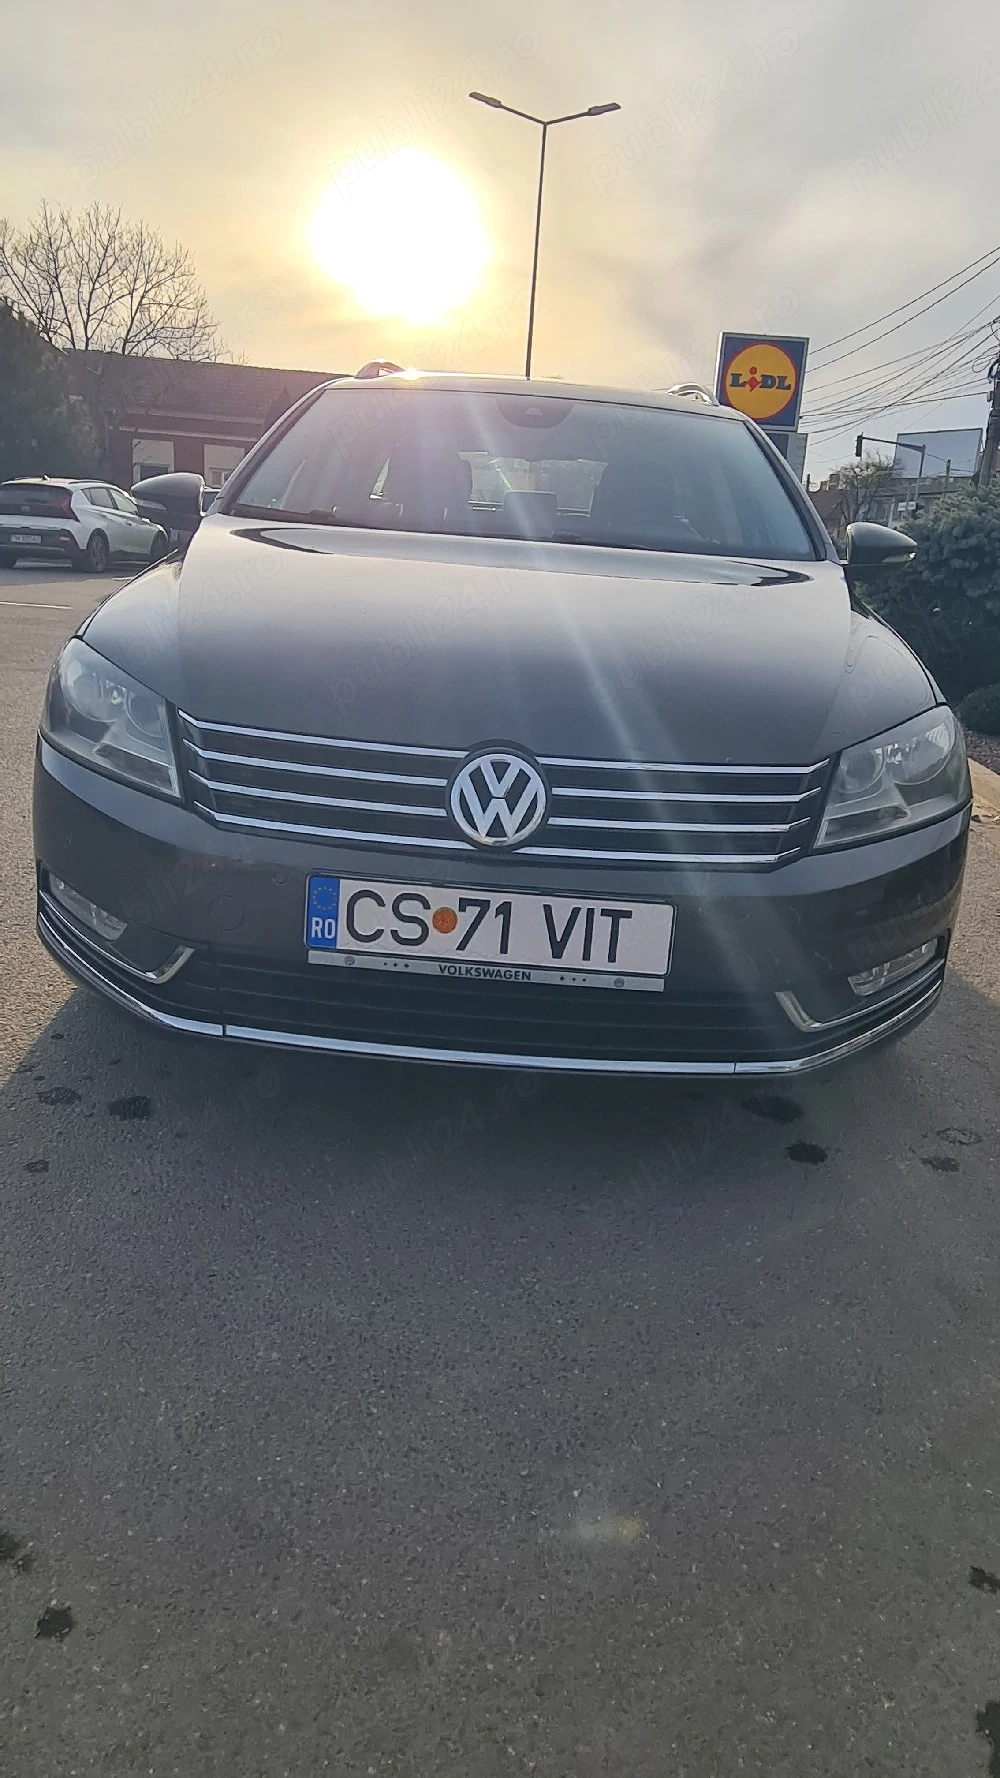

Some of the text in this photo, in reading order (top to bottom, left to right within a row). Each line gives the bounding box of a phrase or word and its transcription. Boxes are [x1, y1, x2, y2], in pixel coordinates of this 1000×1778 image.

[311, 917, 336, 939] RO
[346, 889, 633, 963] CS 71 VIT
[438, 963, 532, 982] VOLKSWAGEN
